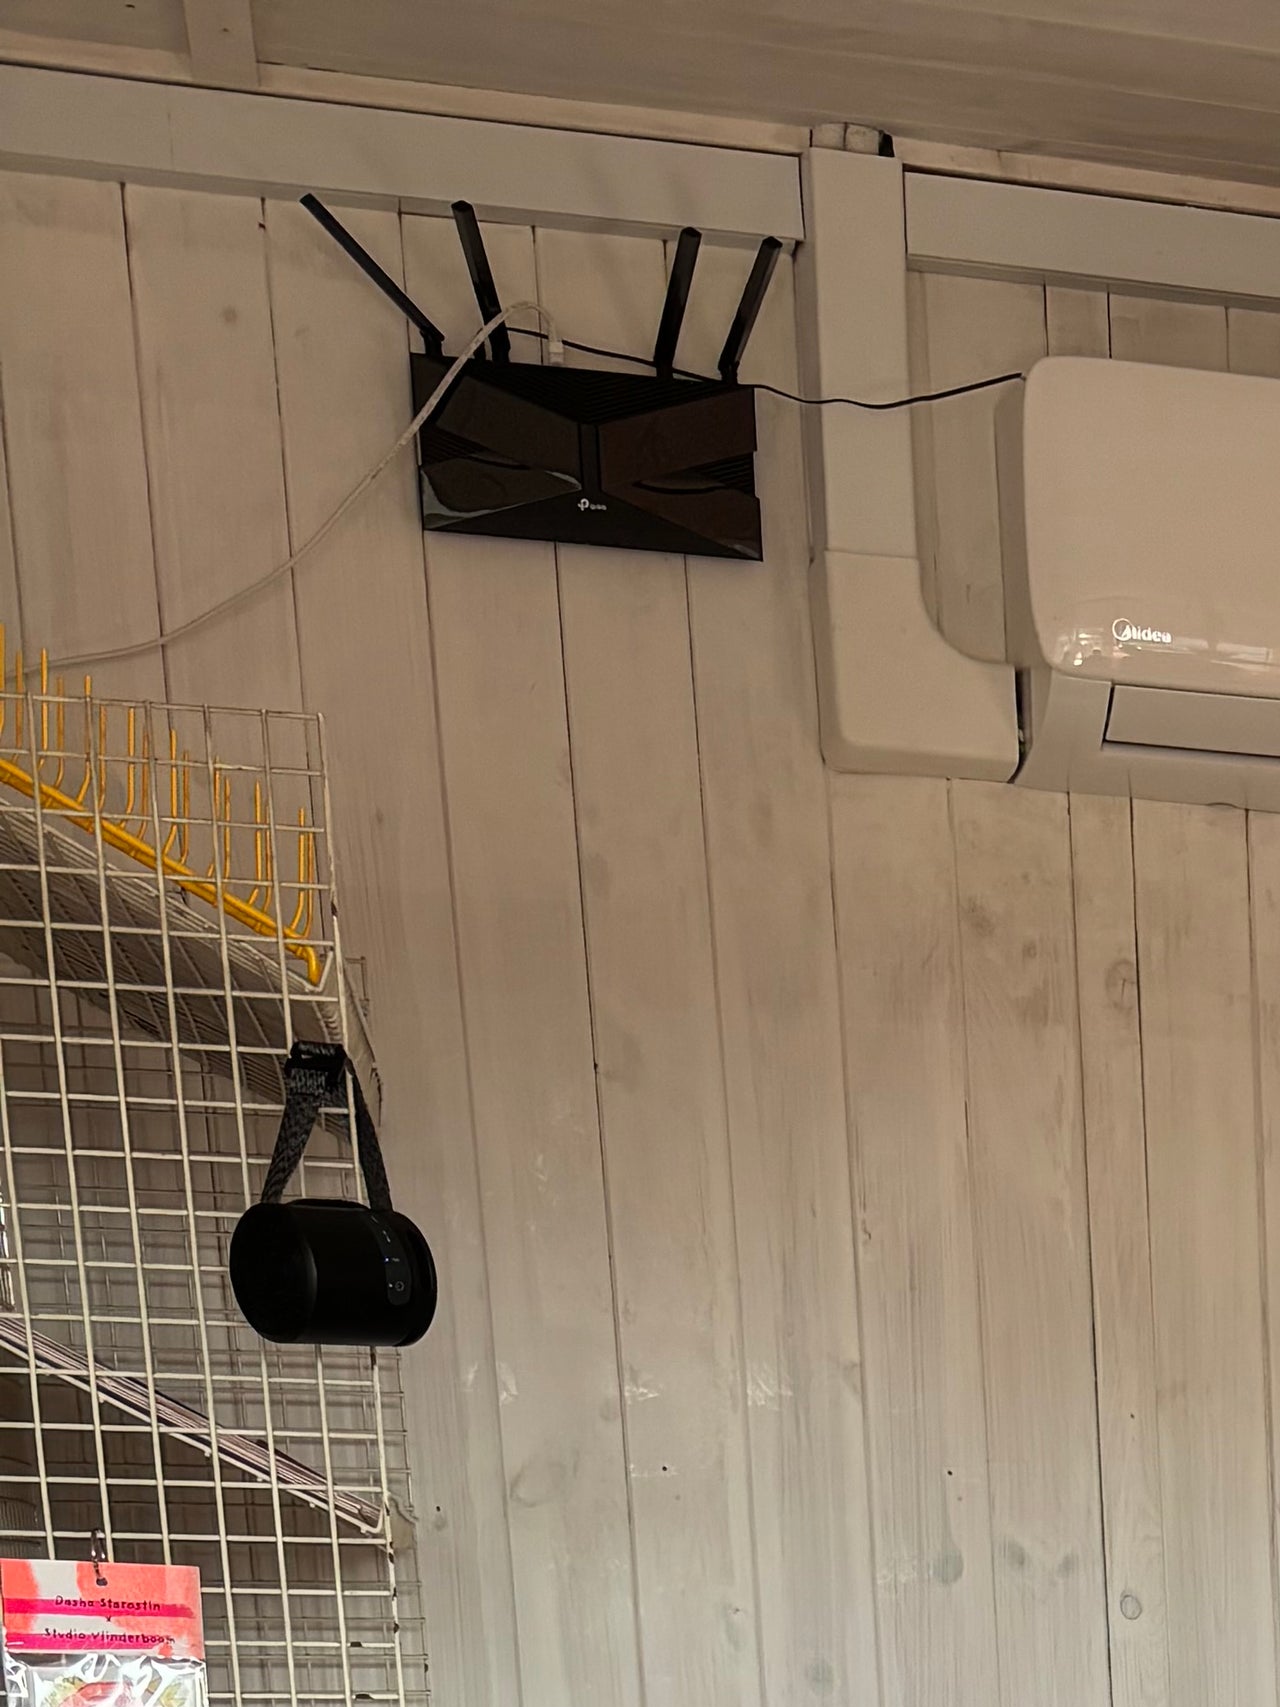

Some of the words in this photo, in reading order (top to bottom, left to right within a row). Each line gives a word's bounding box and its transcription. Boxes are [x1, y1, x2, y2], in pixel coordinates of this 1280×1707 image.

[1113, 619, 1172, 643] Midea
[55, 1595, 95, 1607] Dasha
[100, 1597, 161, 1611] Starostin
[44, 1627, 86, 1640] Studio
